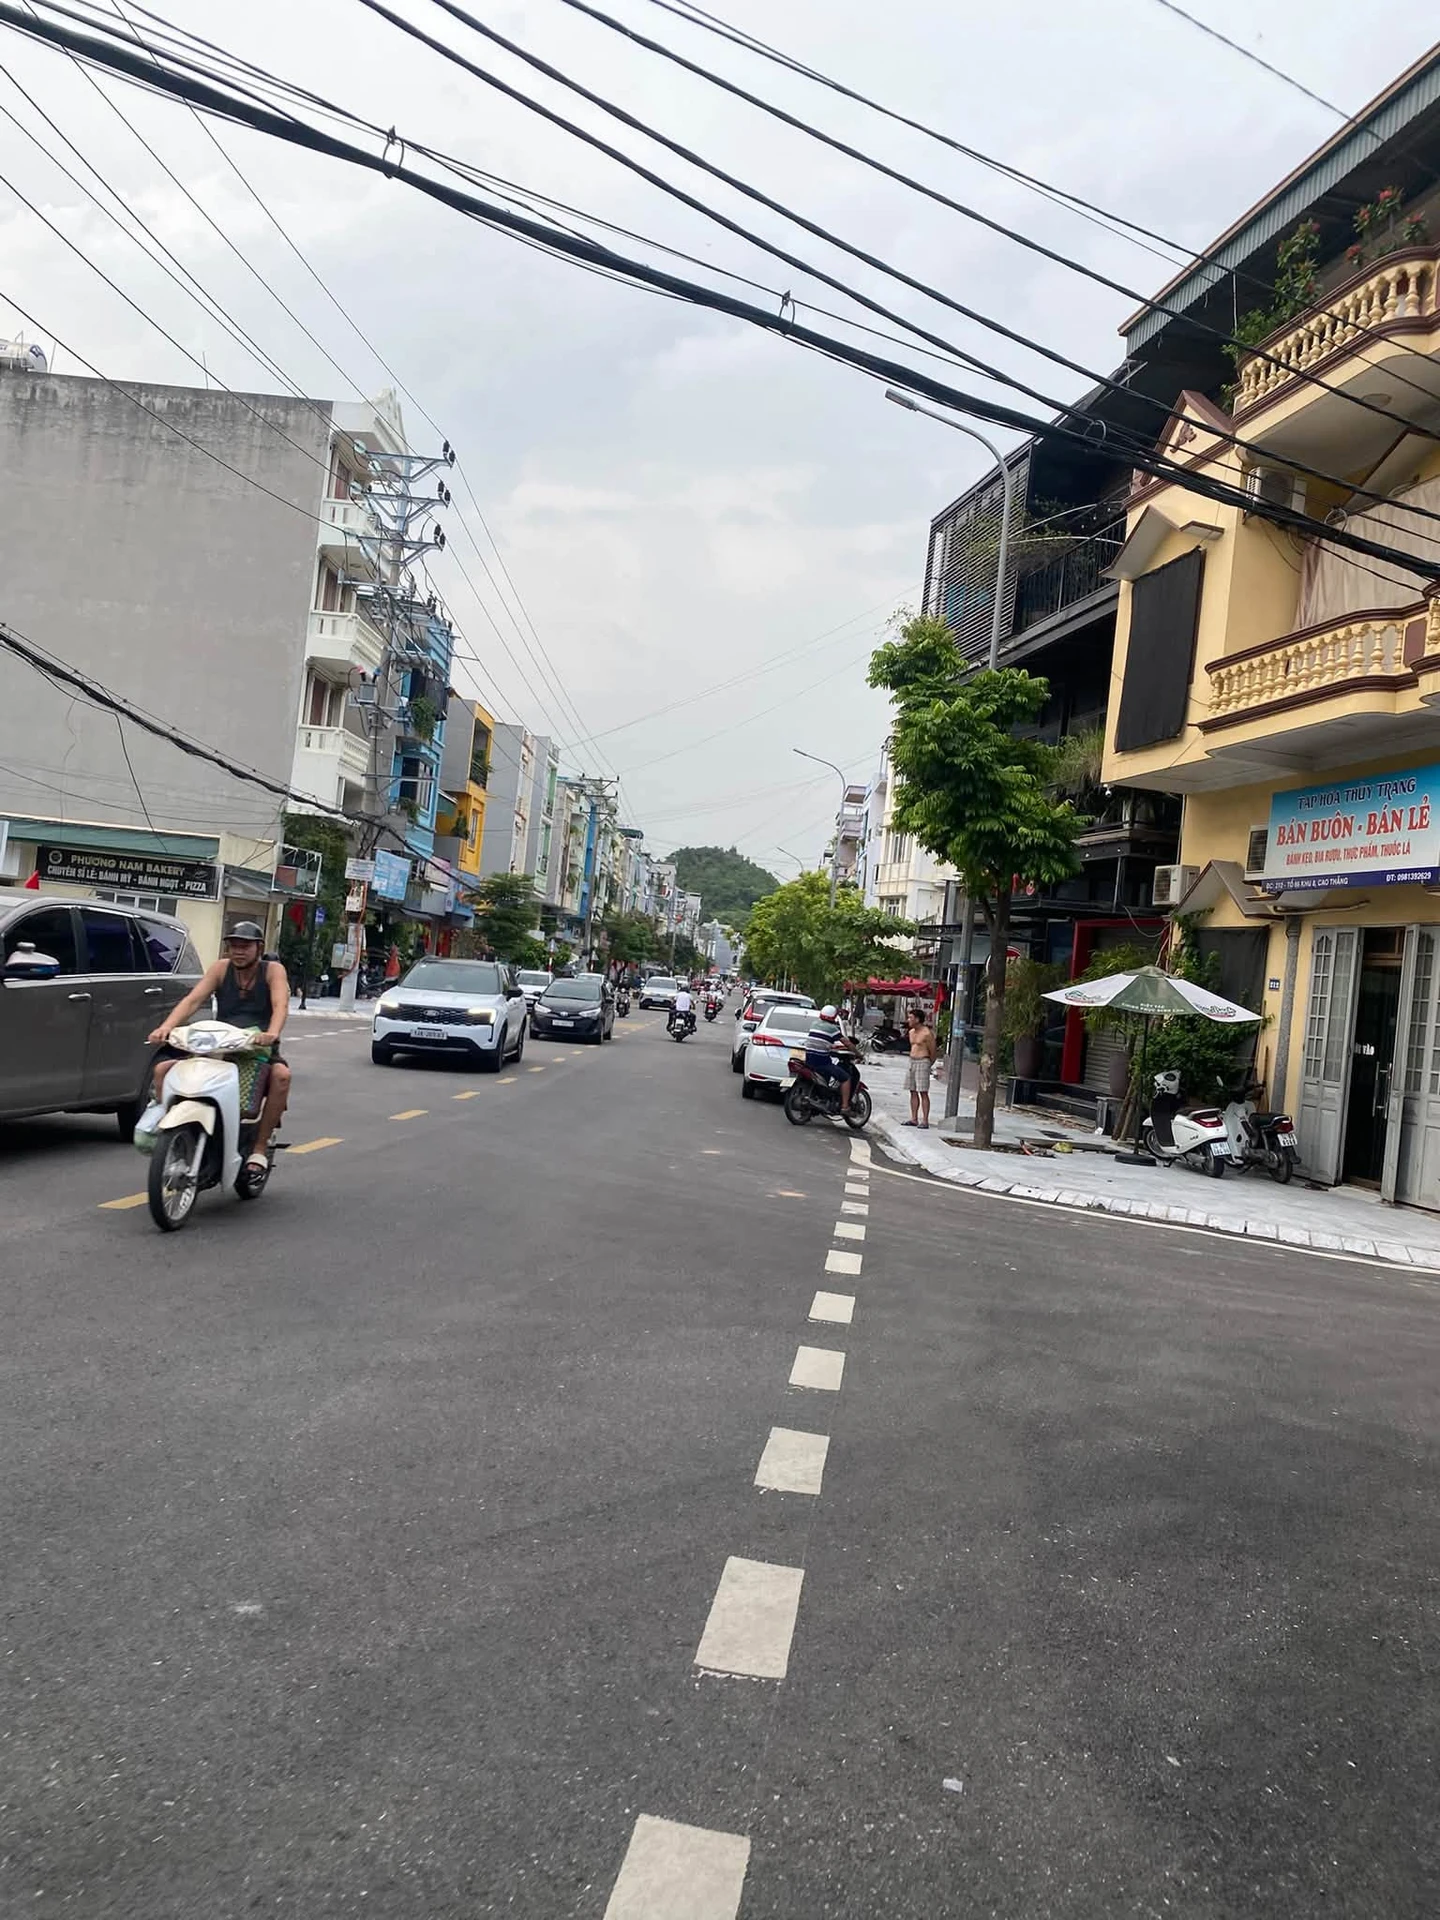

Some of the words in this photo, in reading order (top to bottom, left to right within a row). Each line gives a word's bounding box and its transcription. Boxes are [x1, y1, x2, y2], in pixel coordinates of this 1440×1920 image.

[1377, 778, 1415, 800] TRANG
[1276, 817, 1307, 846] BÁN
[1310, 811, 1354, 842] BUÔN
[1366, 804, 1404, 836] BÁN
[1407, 795, 1431, 831] LẺ
[71, 855, 117, 869] PHƯƠNG
[119, 860, 144, 872] NAM
[146, 862, 186, 877] BAKERY
[185, 880, 208, 893] PIZZA
